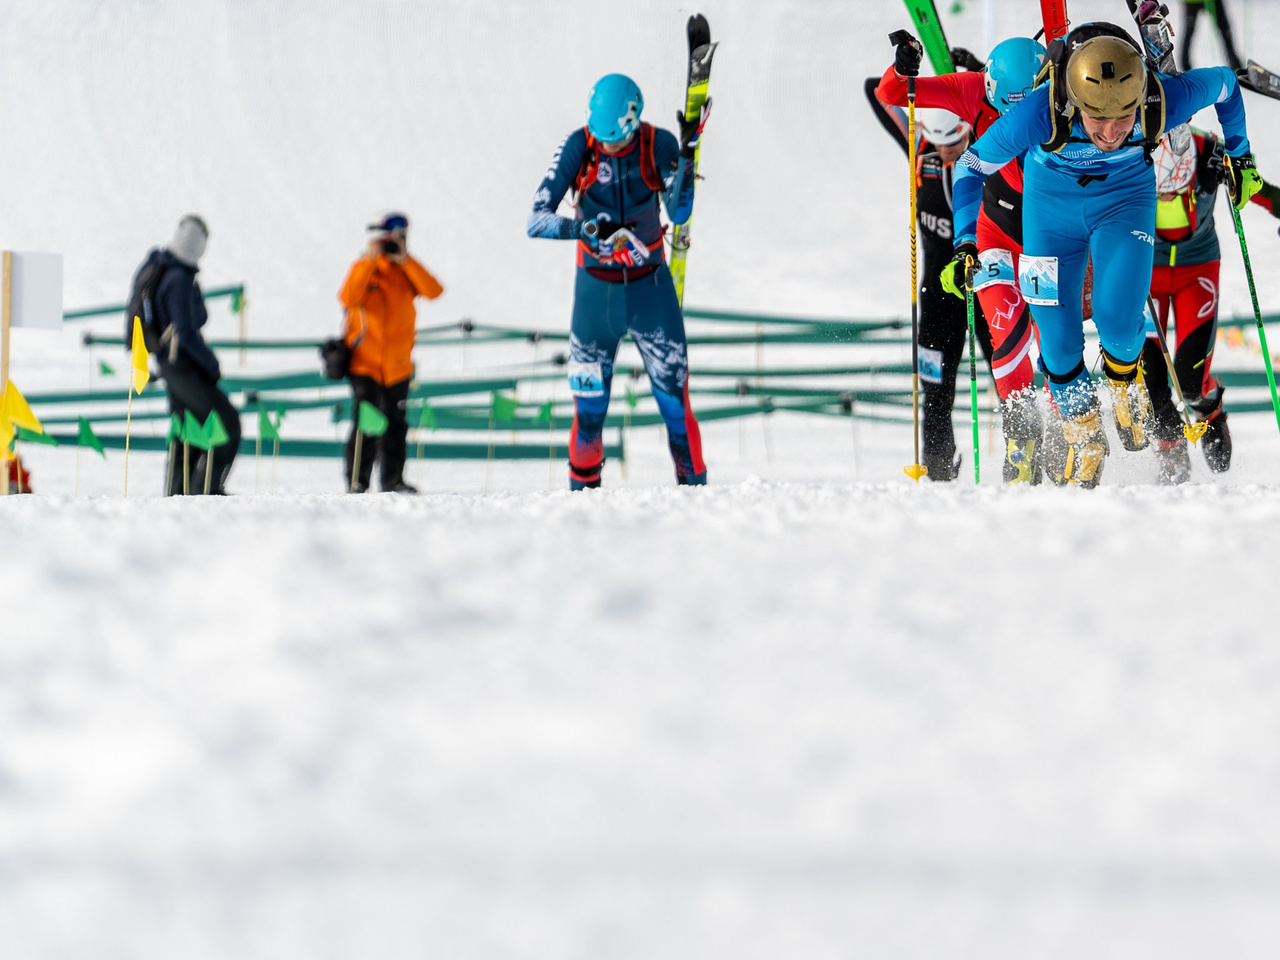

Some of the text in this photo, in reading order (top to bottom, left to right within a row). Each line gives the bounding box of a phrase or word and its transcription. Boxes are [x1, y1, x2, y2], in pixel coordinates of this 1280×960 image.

[921, 210, 952, 239] RUS
[988, 262, 1000, 278] 5
[1031, 276, 1039, 295] 1
[576, 375, 594, 390] 14
